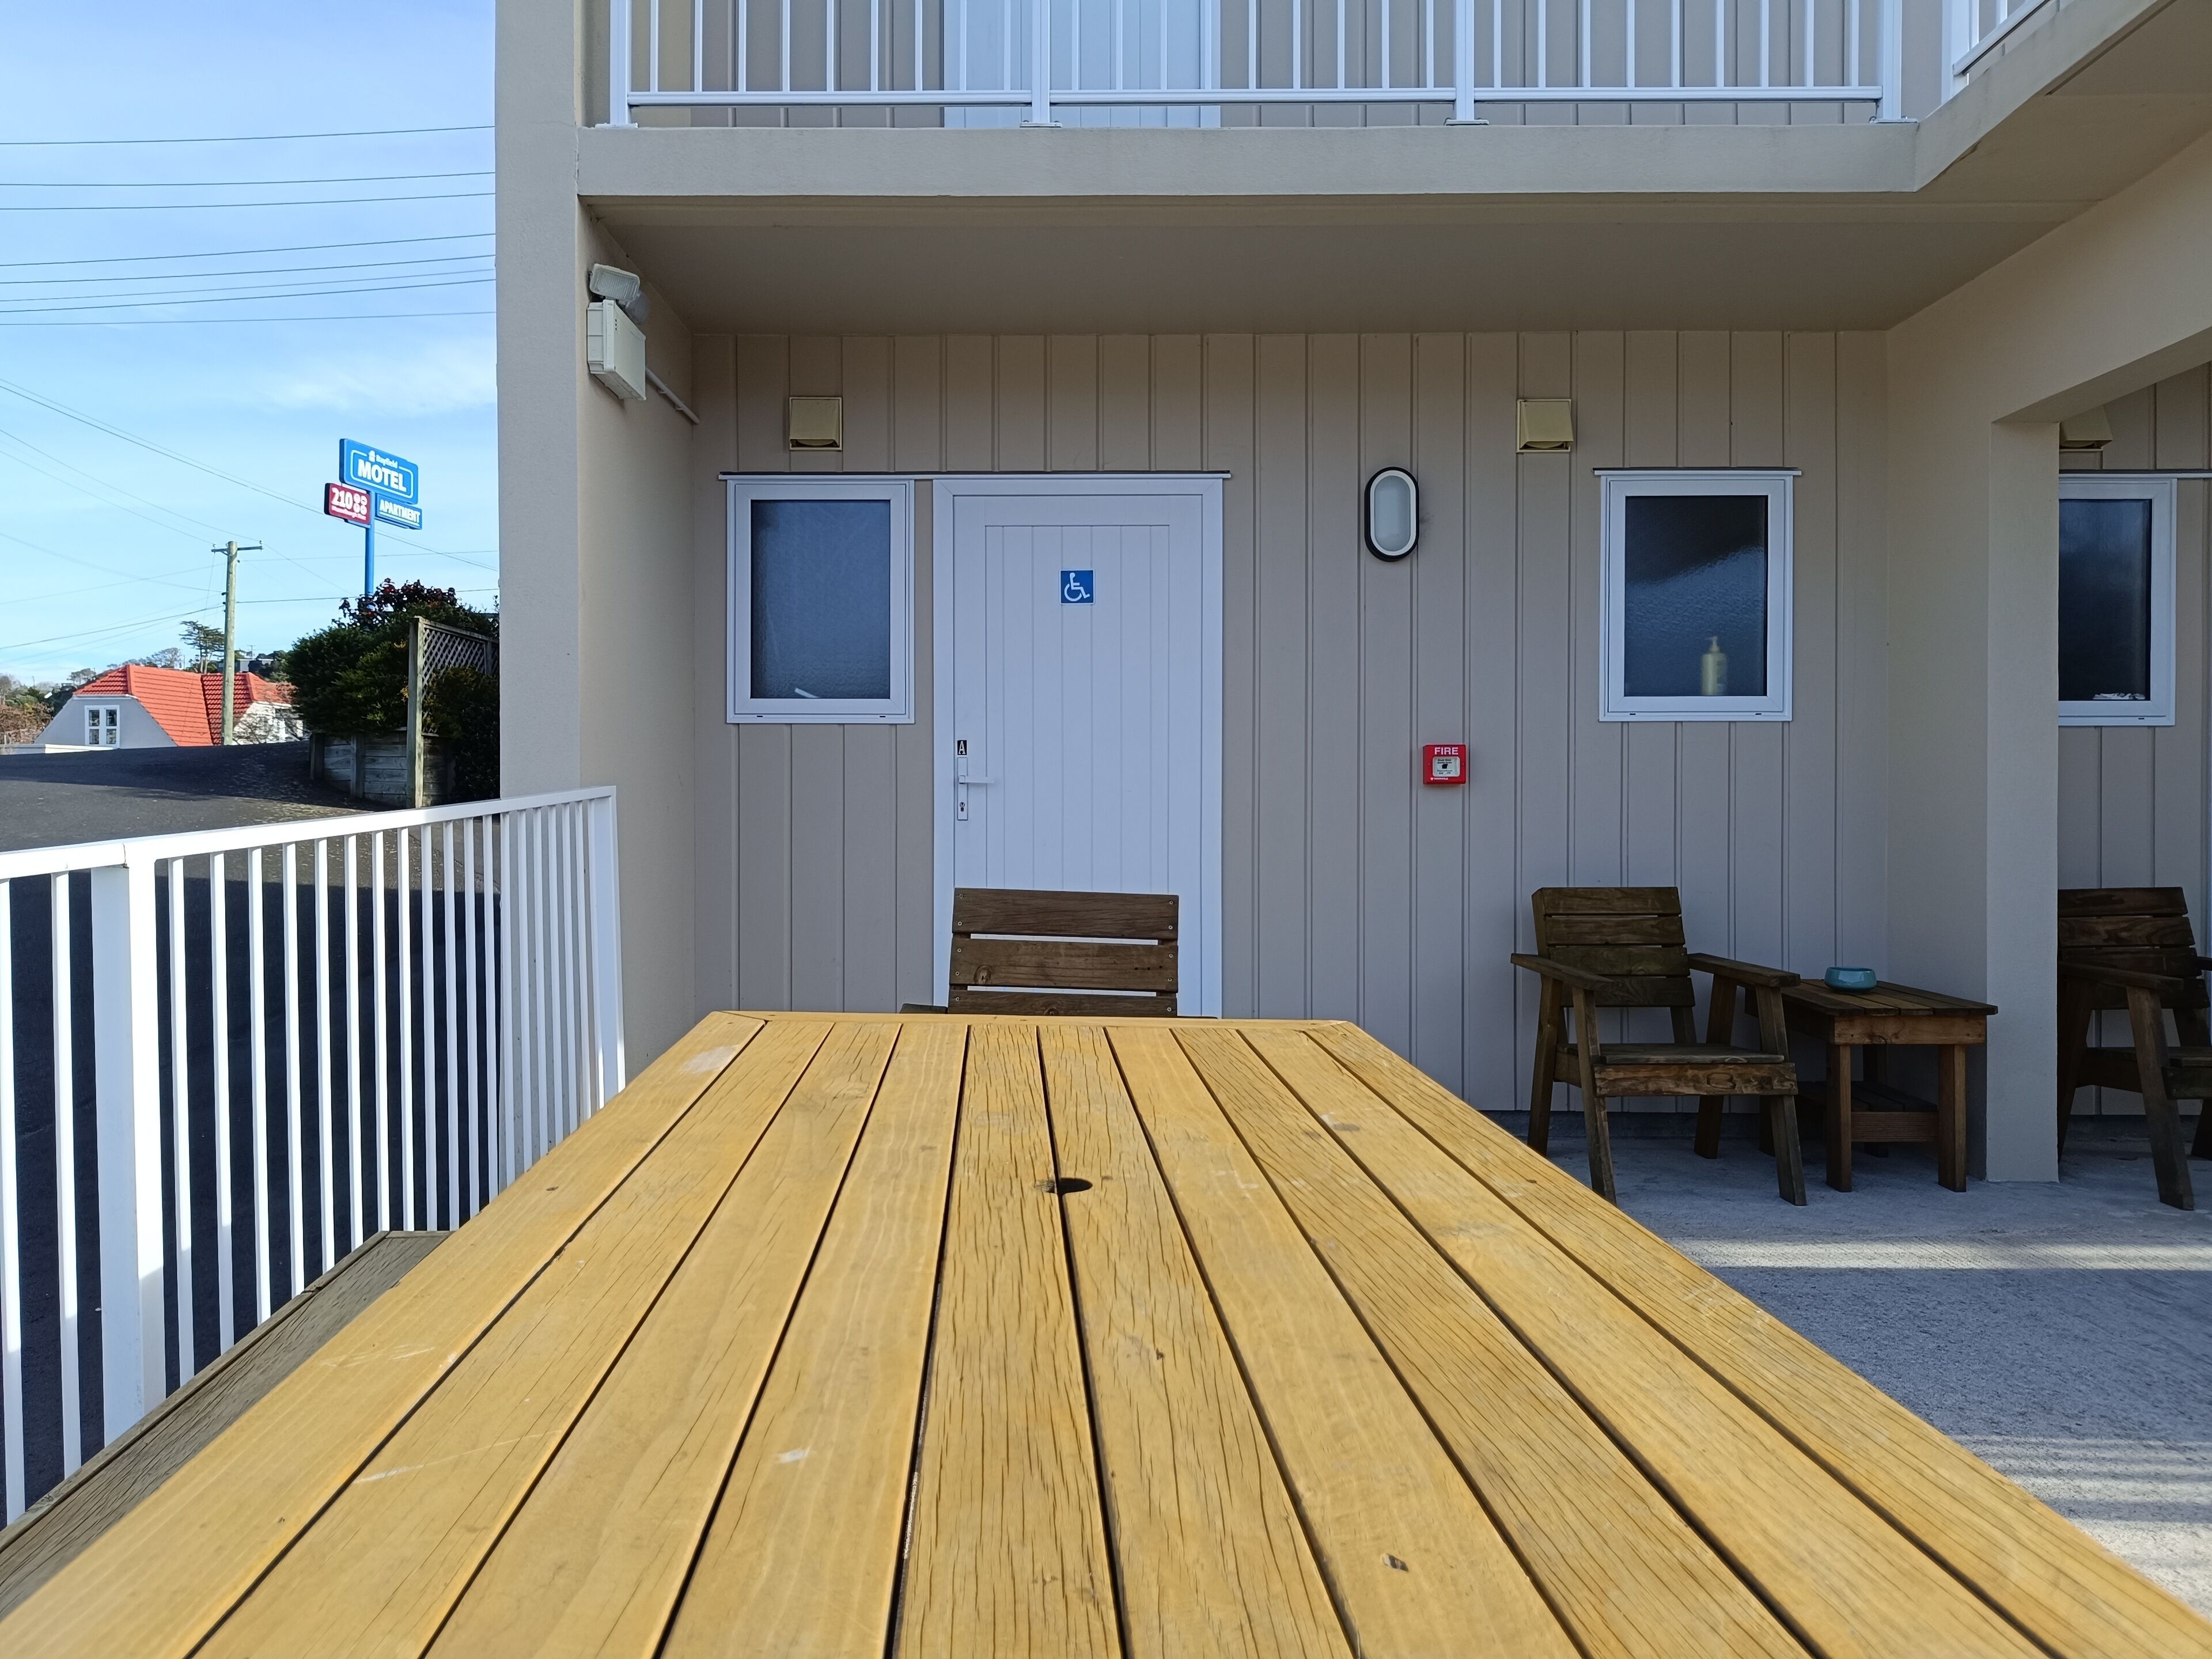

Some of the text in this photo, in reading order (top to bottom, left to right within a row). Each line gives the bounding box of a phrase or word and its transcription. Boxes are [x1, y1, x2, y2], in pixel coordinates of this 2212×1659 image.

[358, 459, 407, 492] MOTEL
[380, 499, 421, 522] APARTMENT
[959, 741, 965, 754] A
